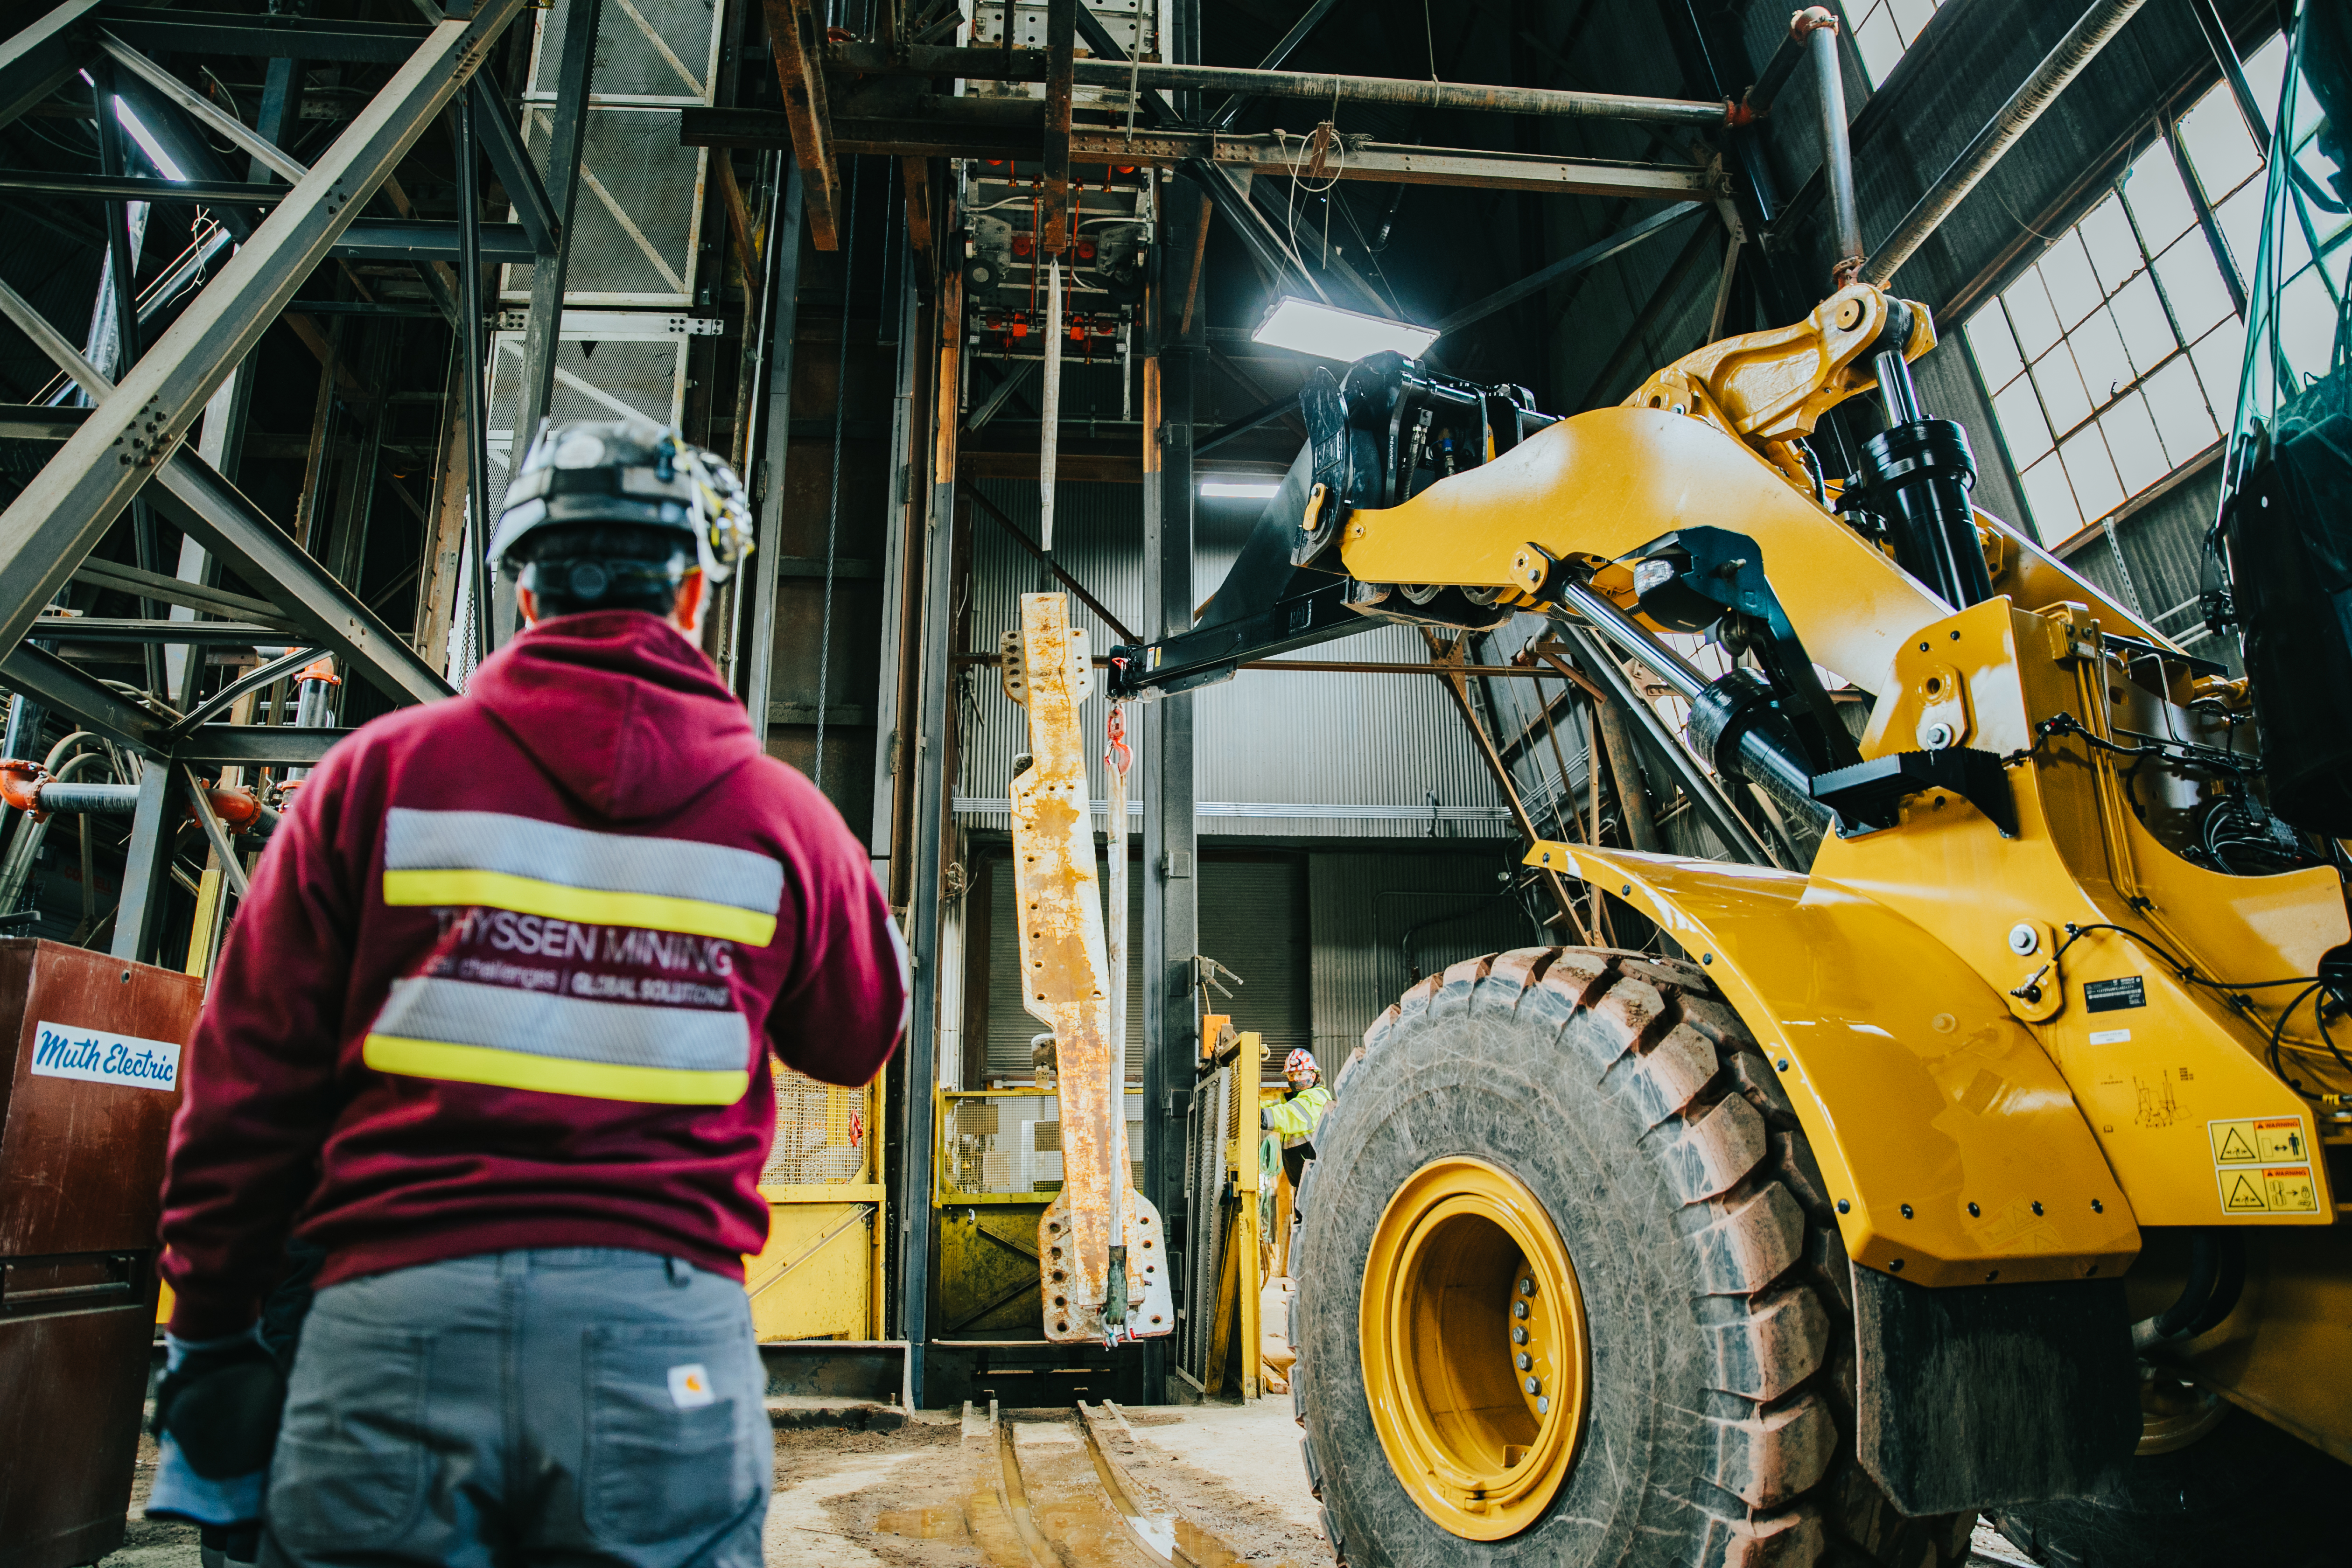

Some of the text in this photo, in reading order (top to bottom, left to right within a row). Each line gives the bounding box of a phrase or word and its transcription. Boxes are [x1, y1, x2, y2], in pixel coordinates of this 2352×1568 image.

[64, 866, 112, 893] COELL
[430, 904, 734, 976] THYSSEN MINING
[36, 1030, 174, 1082] Muth Electric
